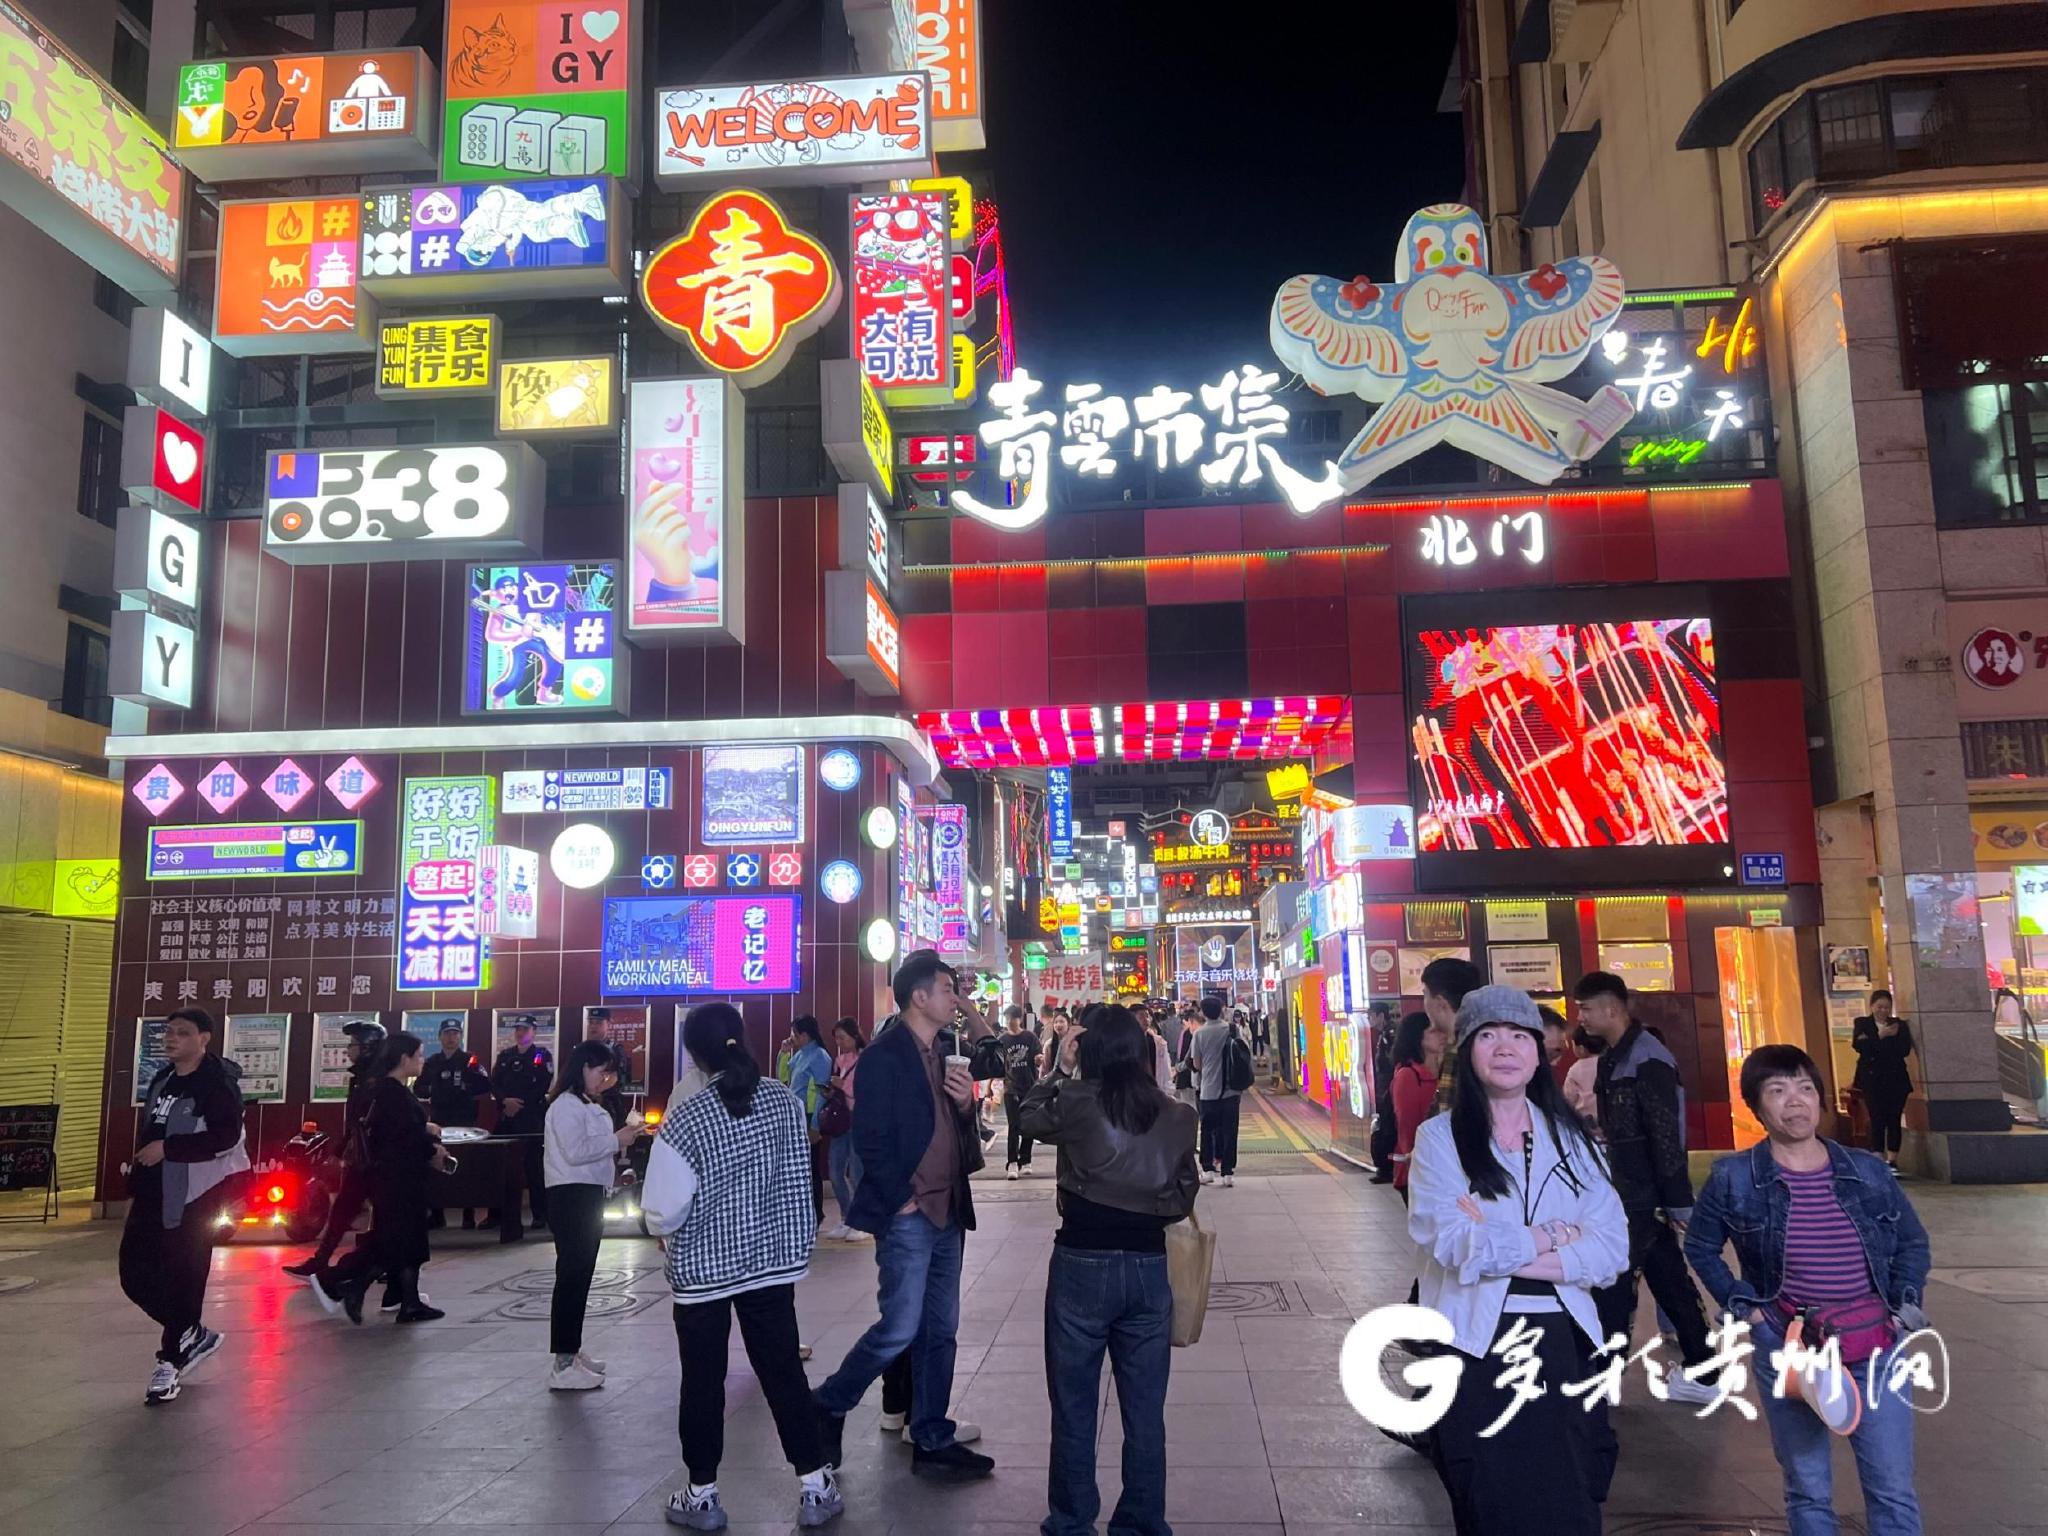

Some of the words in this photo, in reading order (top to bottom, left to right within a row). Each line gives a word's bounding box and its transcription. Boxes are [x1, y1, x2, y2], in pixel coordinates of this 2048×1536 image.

[560, 13, 573, 45] I
[552, 50, 614, 84] GY
[917, 0, 951, 110] OME
[667, 97, 921, 149] WELCOME
[676, 207, 815, 357] 青
[382, 328, 407, 345] QING
[864, 306, 939, 346] 大有
[383, 347, 406, 364] YUN
[410, 353, 486, 383] 行乐
[866, 346, 939, 382] 可玩
[382, 368, 405, 384] FUN
[1420, 512, 1546, 566] 北门
[160, 535, 184, 588] G
[155, 636, 181, 689] Y
[146, 769, 365, 800] 贵阳味道
[411, 785, 481, 821] 好好
[410, 825, 481, 861] 干饭
[708, 821, 793, 834] QINGYUNFUN
[413, 865, 475, 892] 整起!
[1761, 867, 1782, 878] 102
[151, 897, 282, 916] 社会主义核心价值观
[287, 898, 396, 917] 网聚文明力量
[284, 920, 395, 940] 点亮美好生活
[405, 905, 476, 943] 天天
[743, 906, 767, 982] 老记忆
[403, 946, 476, 982] 减肥
[607, 960, 654, 973] FAMILY
[660, 959, 695, 972] MEAL
[607, 973, 670, 986] WORKING
[676, 972, 710, 985] MEAL
[143, 975, 372, 1001] 爽爽贵阳欢迎您
